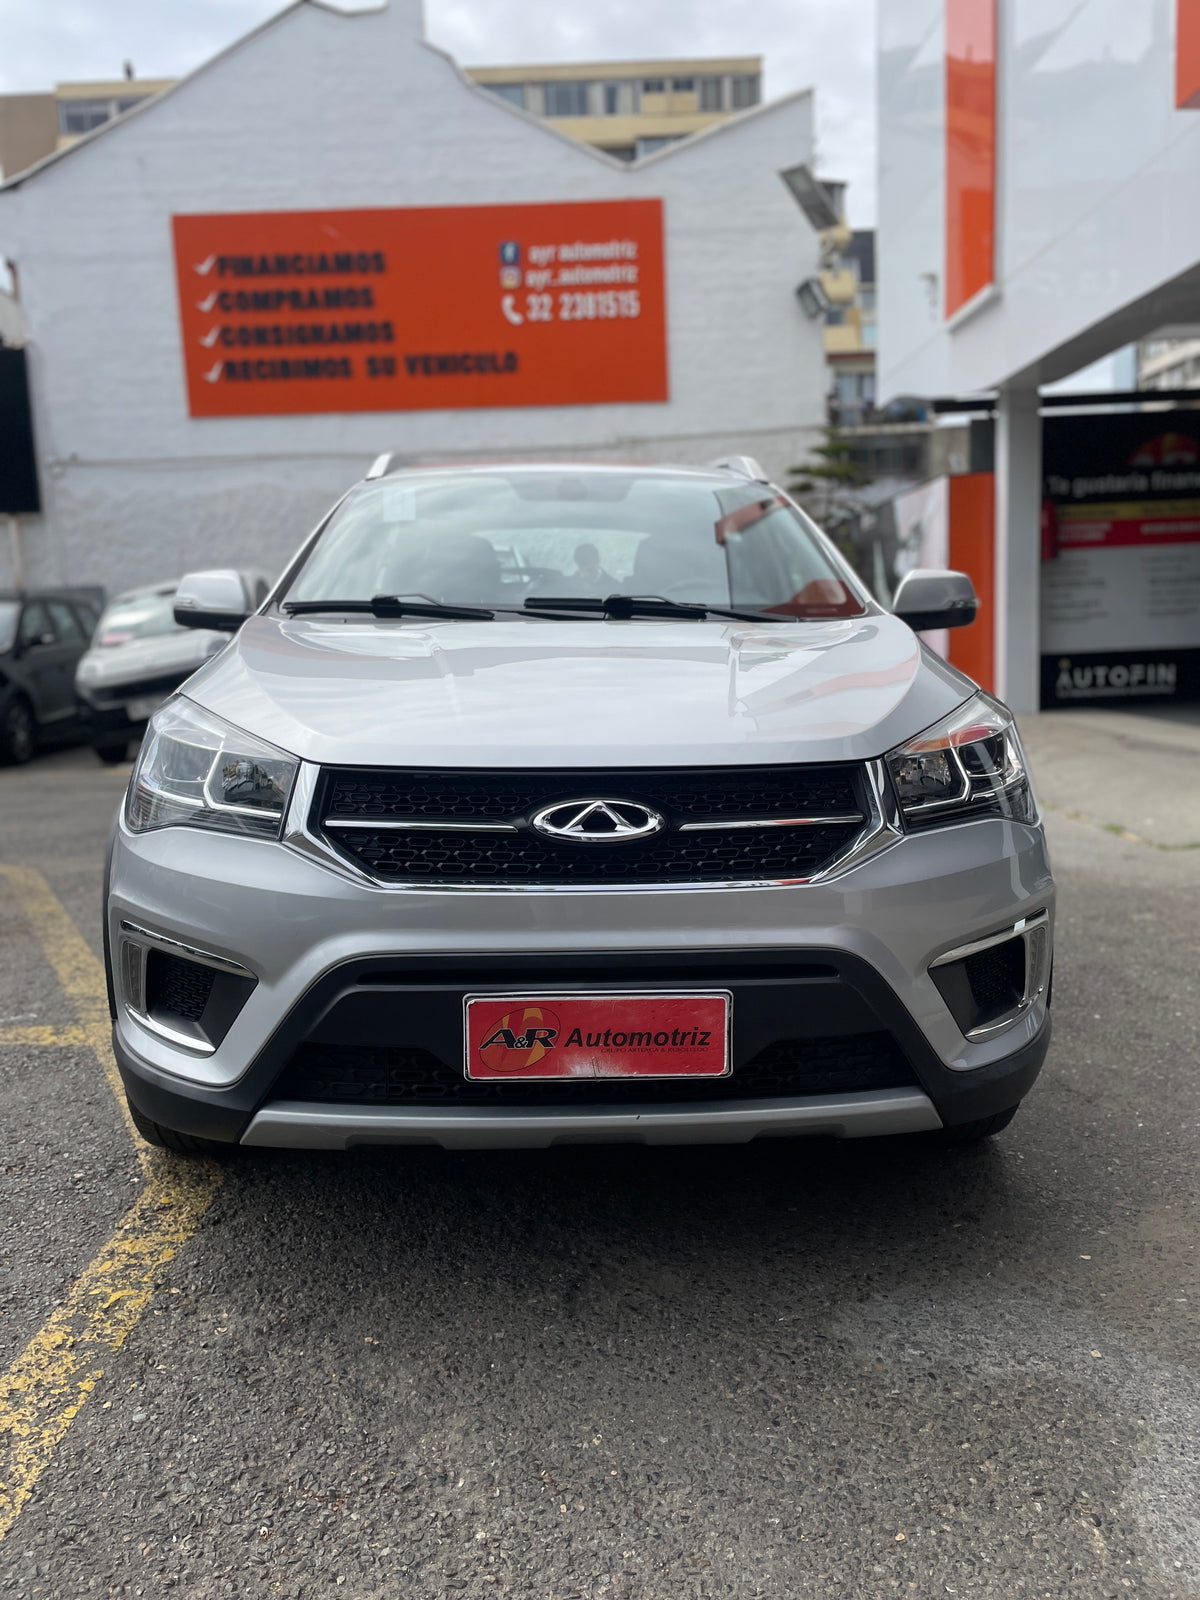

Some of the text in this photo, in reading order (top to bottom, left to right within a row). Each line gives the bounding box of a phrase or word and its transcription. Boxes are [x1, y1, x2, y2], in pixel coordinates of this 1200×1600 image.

[557, 239, 638, 262] automotriz
[218, 252, 386, 276] FINANCIAMOS
[219, 286, 374, 313] COMPRAMOS
[526, 293, 553, 322] 32
[220, 320, 394, 346] CONSIGNAMOS
[225, 351, 518, 382] RECIBIMOS SU VEHICULO
[1056, 662, 1177, 690] AUTOFIN
[564, 1027, 712, 1047] Automotriz
